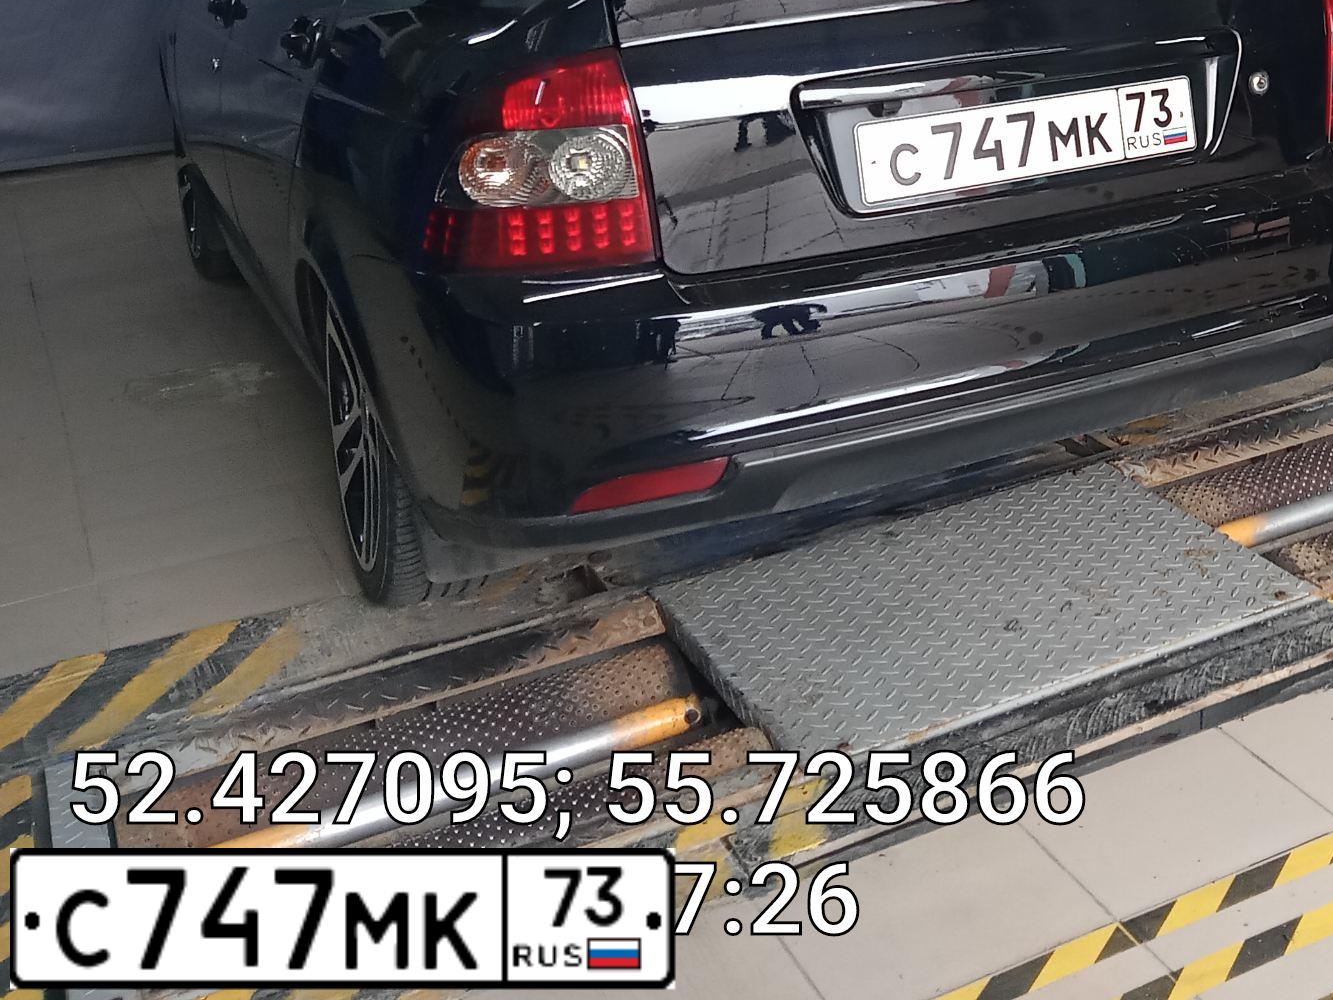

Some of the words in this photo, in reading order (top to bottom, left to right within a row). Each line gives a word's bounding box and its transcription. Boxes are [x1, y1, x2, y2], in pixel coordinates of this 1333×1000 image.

[889, 111, 1113, 187] С747МК
[1125, 88, 1173, 133] 73
[1126, 131, 1163, 151] RUS
